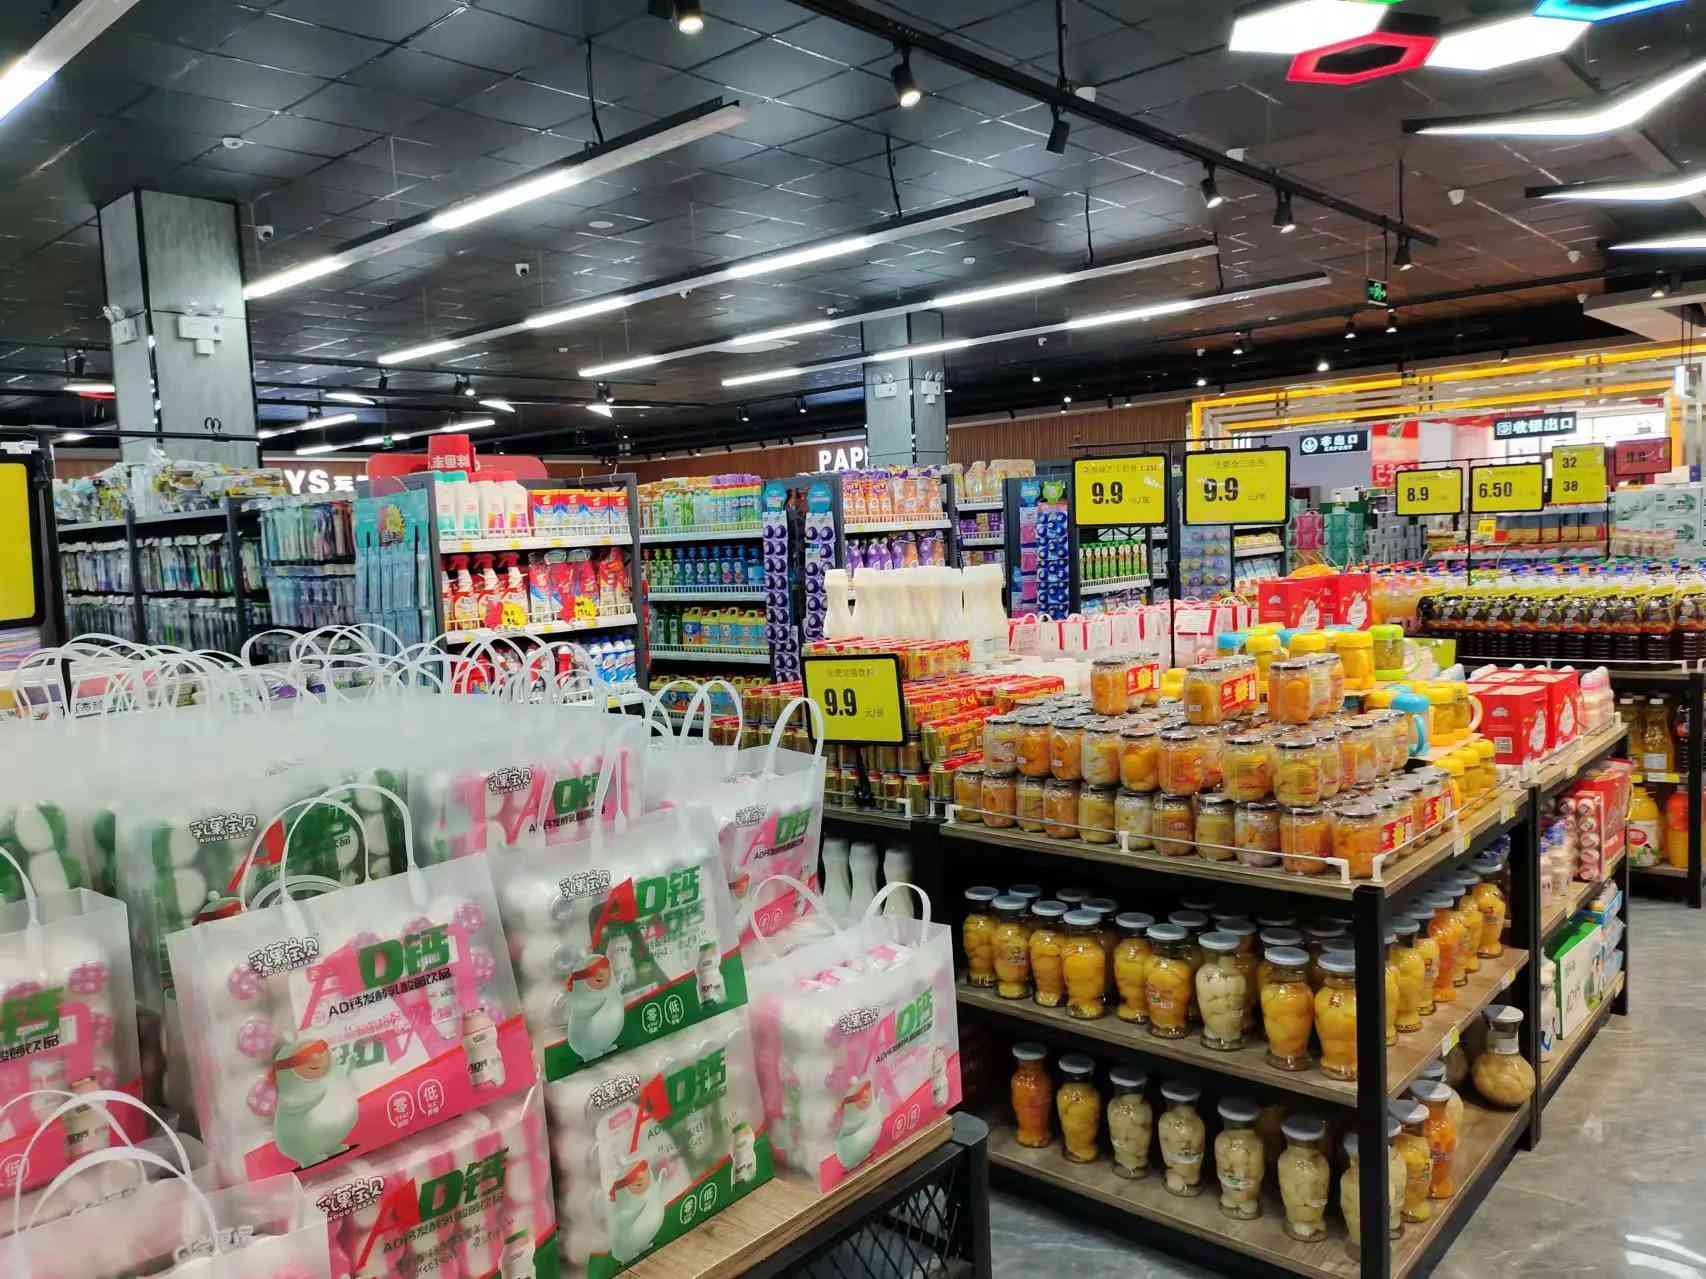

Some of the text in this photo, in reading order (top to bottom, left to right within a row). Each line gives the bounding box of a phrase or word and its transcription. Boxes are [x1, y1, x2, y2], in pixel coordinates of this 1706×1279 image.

[1513, 417, 1573, 434] 收银出口
[1562, 457, 1577, 469] 32
[1091, 481, 1123, 505] 9.9
[1204, 477, 1239, 502] 9.9
[1407, 486, 1429, 502] 8.9
[1479, 482, 1512, 498] 6.50
[1562, 480, 1578, 492] 38
[824, 688, 857, 716] 9.9
